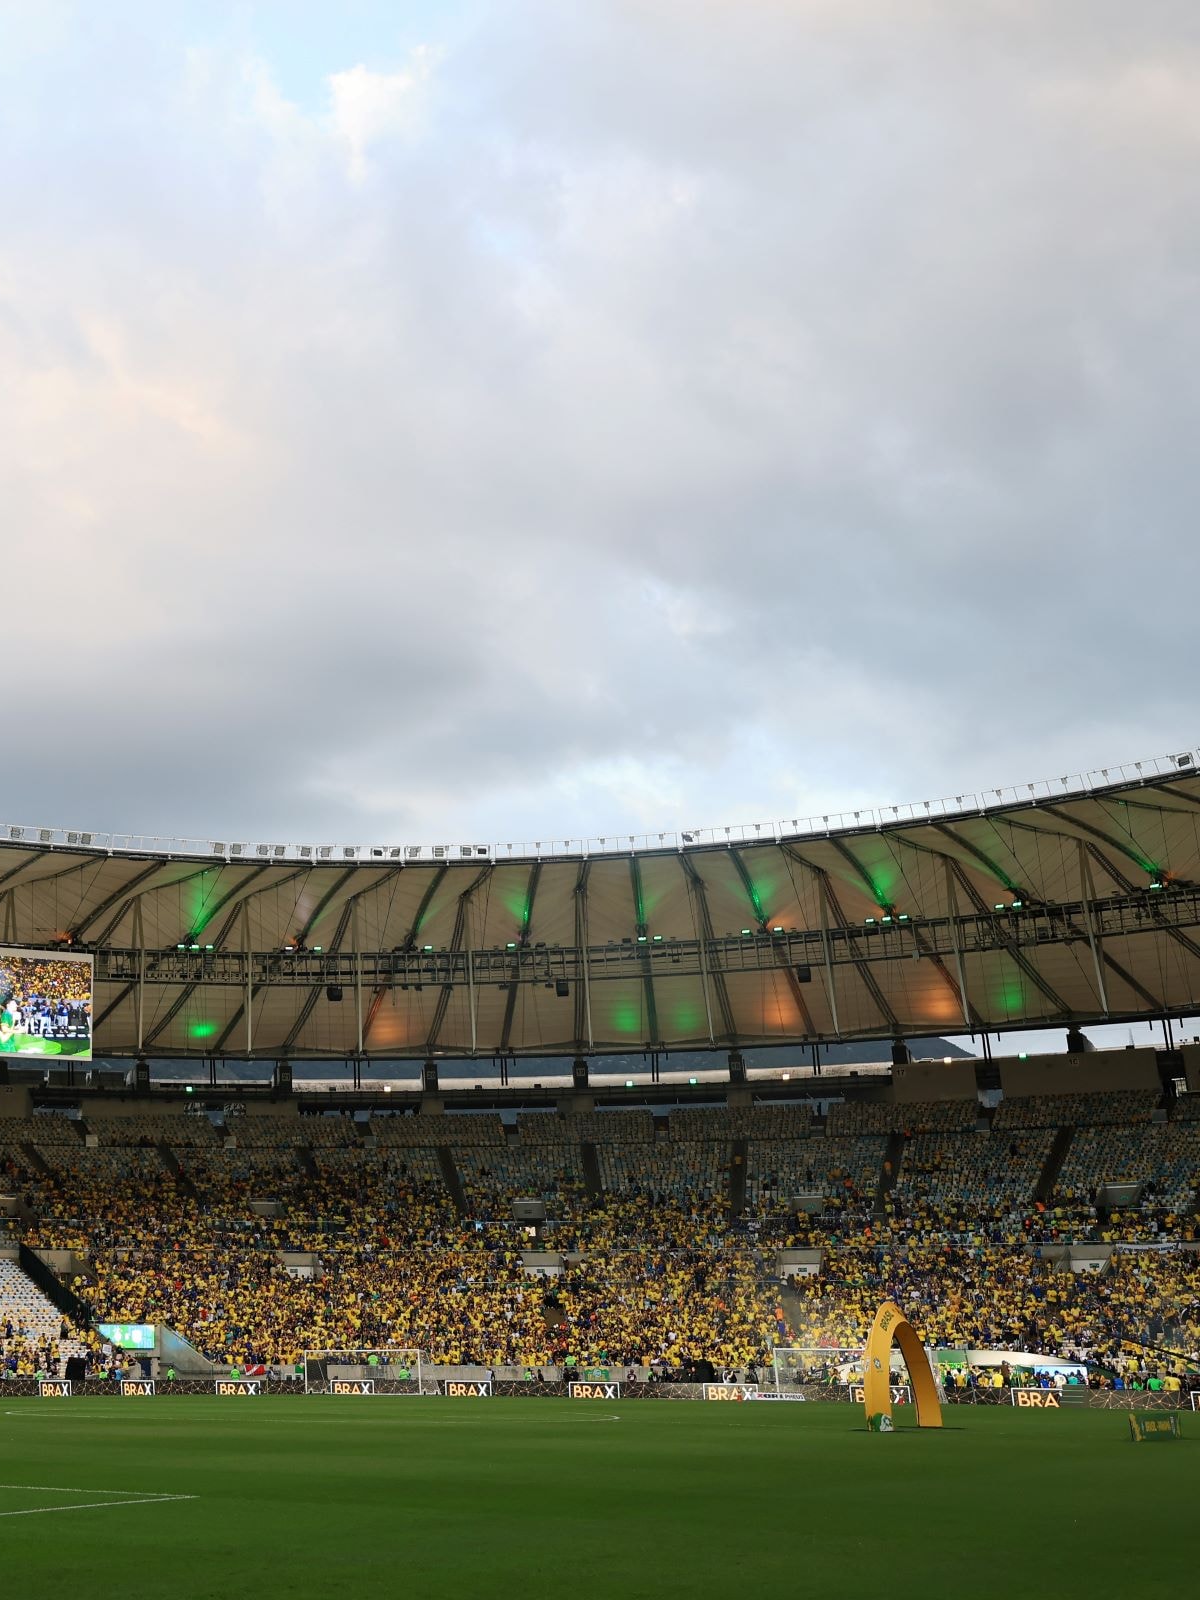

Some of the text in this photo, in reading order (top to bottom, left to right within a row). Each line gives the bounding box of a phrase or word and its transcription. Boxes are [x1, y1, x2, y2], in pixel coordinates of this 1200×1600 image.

[42, 1384, 68, 1396] BRAX
[124, 1384, 151, 1395] BRAX
[220, 1384, 256, 1395] BRAX
[334, 1383, 369, 1394] BRAX
[449, 1384, 487, 1396] BRAX
[573, 1385, 615, 1398] BRAX
[708, 1386, 752, 1400] BRAX
[855, 1389, 905, 1403] BX
